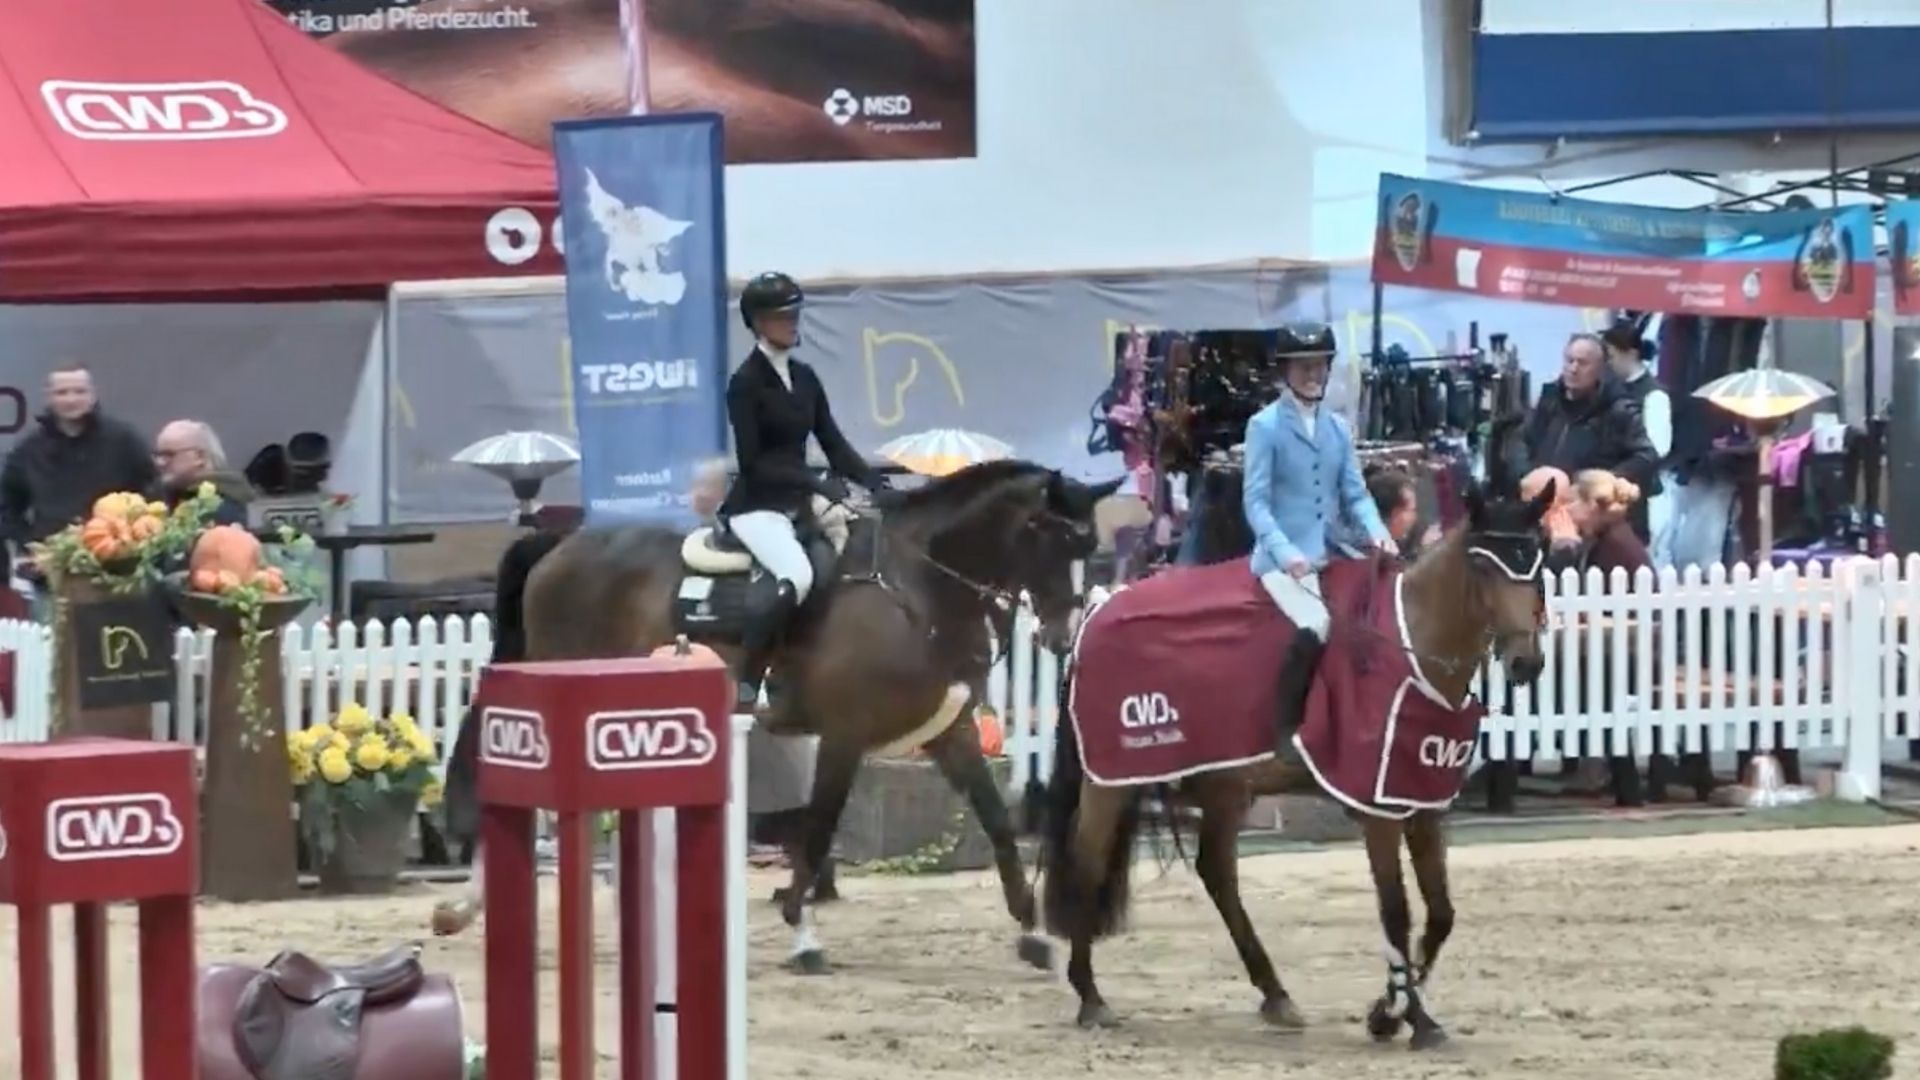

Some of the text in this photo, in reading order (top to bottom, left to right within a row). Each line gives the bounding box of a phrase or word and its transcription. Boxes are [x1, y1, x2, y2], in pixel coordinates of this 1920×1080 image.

[337, 9, 382, 31] und
[388, 7, 538, 30] Pferdezucht.
[66, 93, 230, 131] CWD
[863, 96, 912, 116] MSD
[1120, 692, 1169, 729] CWD
[489, 717, 535, 755] CWD
[597, 720, 688, 759] CWD
[58, 806, 153, 848] CWD
